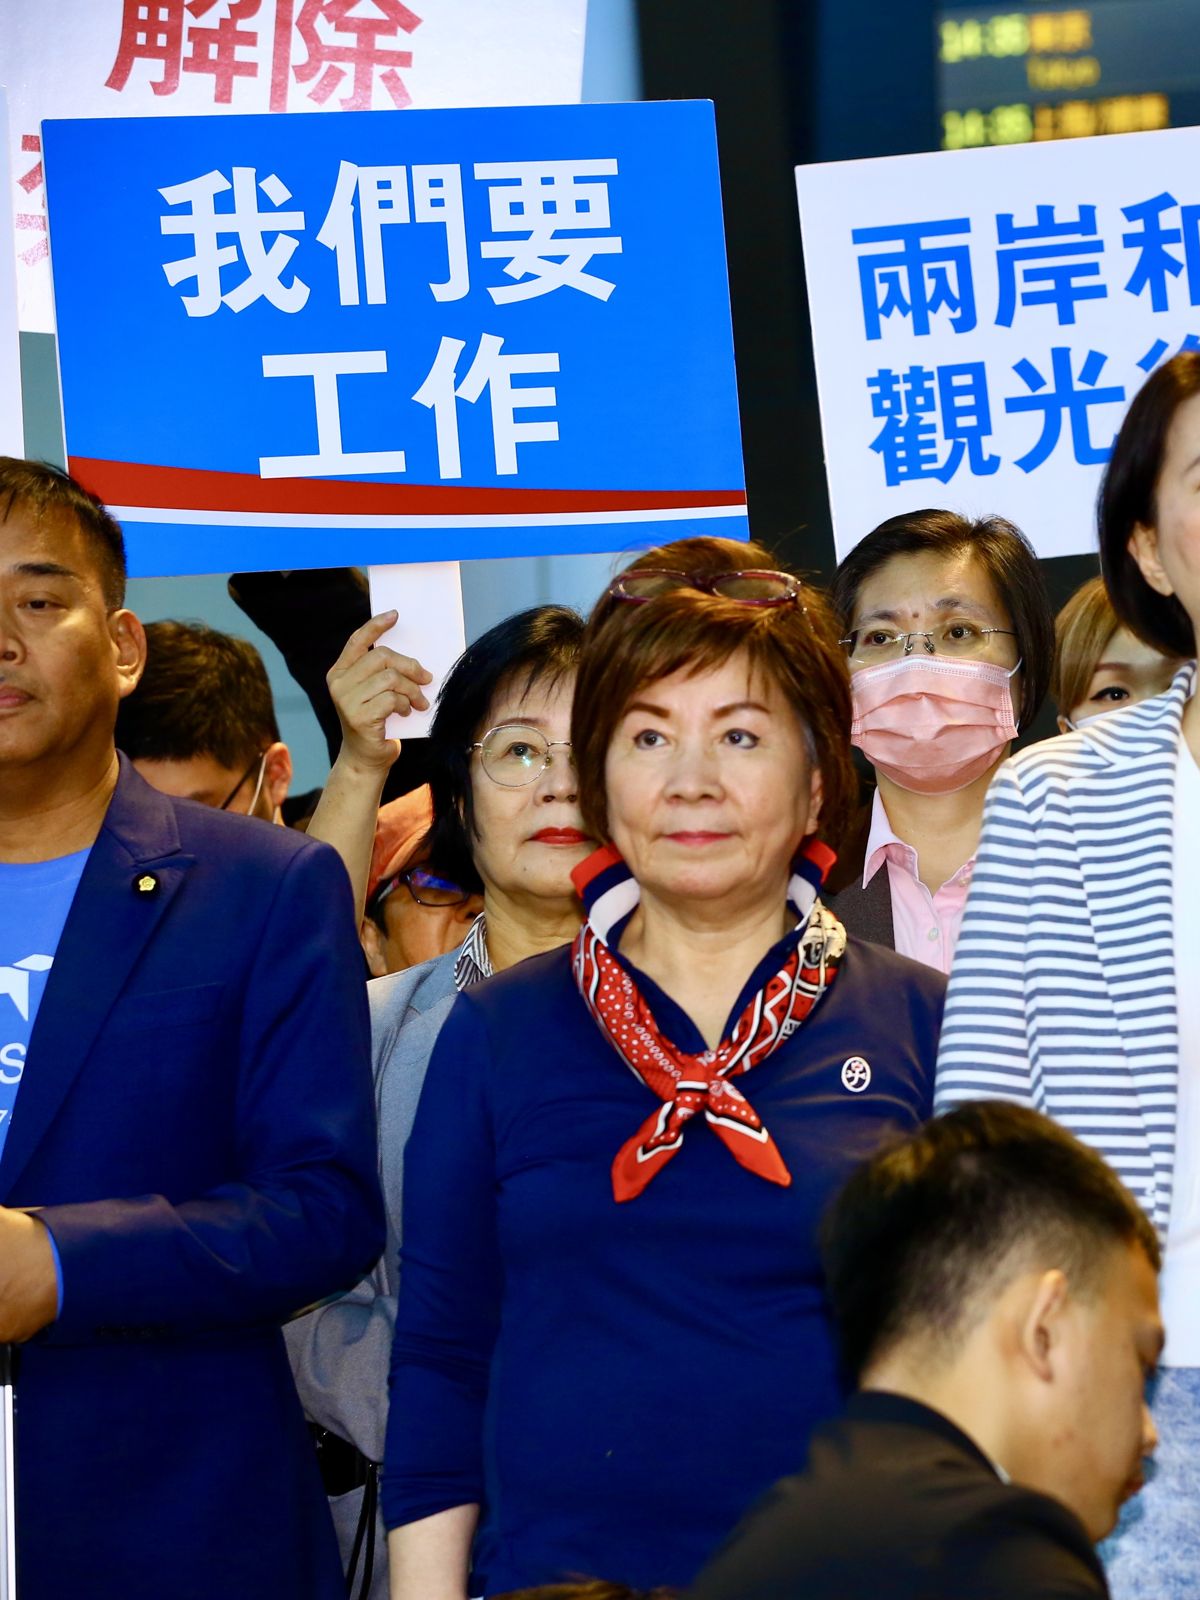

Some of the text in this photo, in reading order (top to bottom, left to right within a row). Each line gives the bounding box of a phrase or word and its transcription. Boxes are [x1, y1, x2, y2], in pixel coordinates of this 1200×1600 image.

[104, 0, 424, 112] 解除
[157, 159, 622, 317] 我們要
[259, 333, 559, 479] 工作
